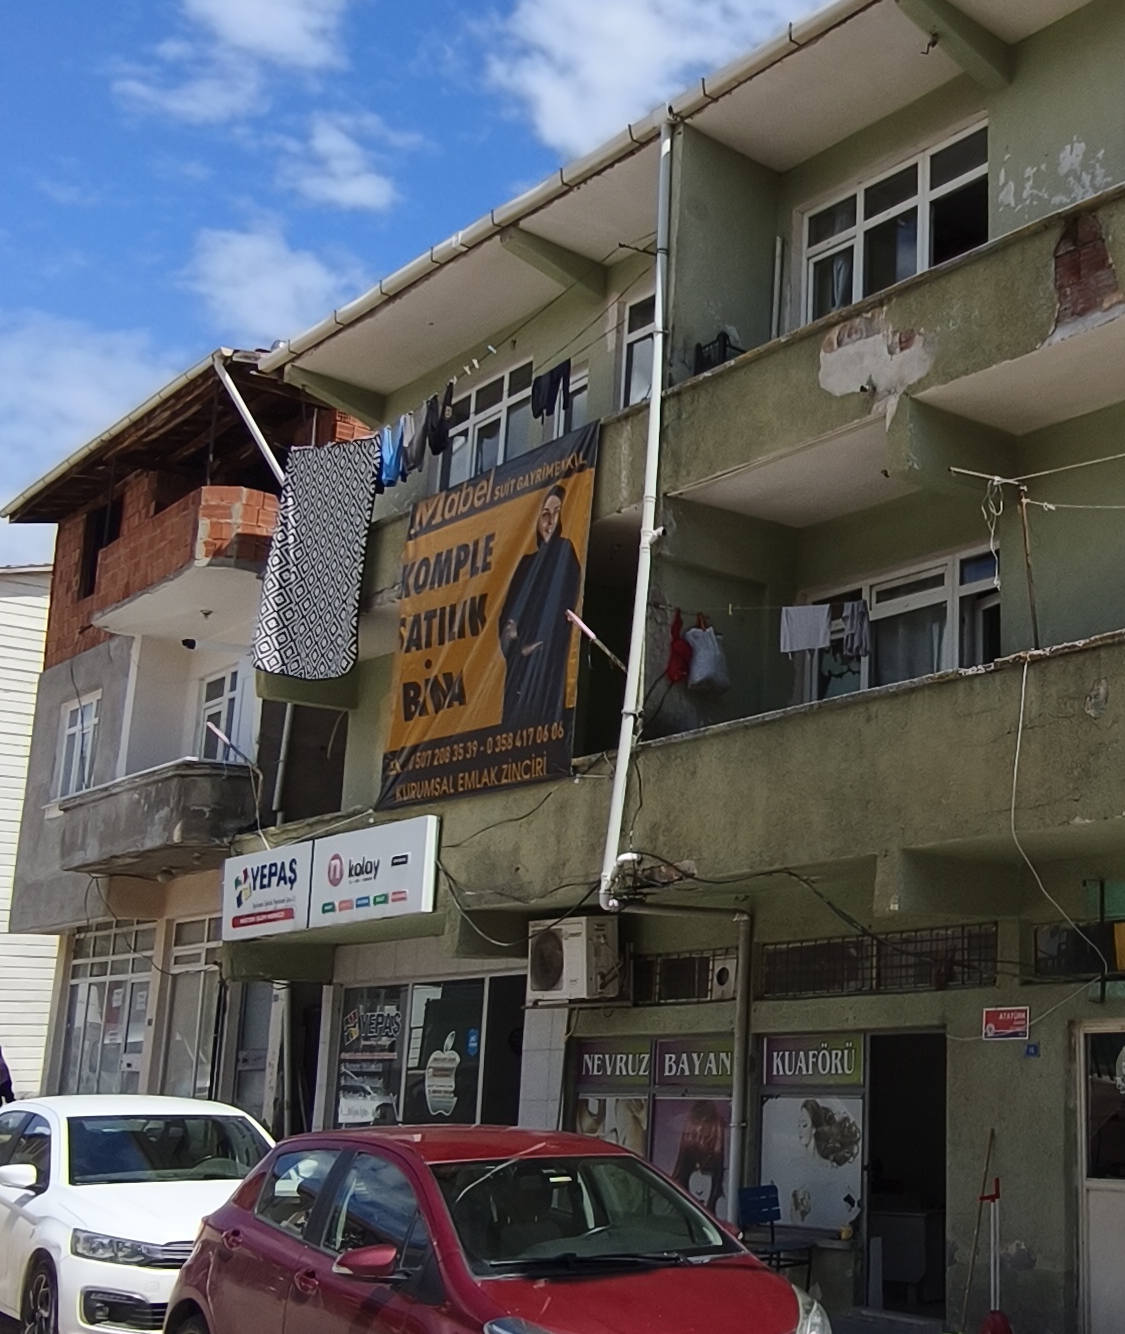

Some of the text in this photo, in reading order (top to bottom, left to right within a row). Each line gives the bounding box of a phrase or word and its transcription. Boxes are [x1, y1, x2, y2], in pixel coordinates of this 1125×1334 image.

[411, 468, 495, 533] Mabel
[400, 532, 496, 599] KOMPLE
[403, 659, 466, 722] BİNA
[452, 744, 465, 762] 35
[396, 751, 547, 802] KURUMSAL EMLAK ZİNCİRİ
[251, 858, 297, 891] YEPAŞ
[348, 856, 380, 880] kolay
[582, 1042, 855, 1077] NEVRUZ BAYAN KUAFÖRÜ
